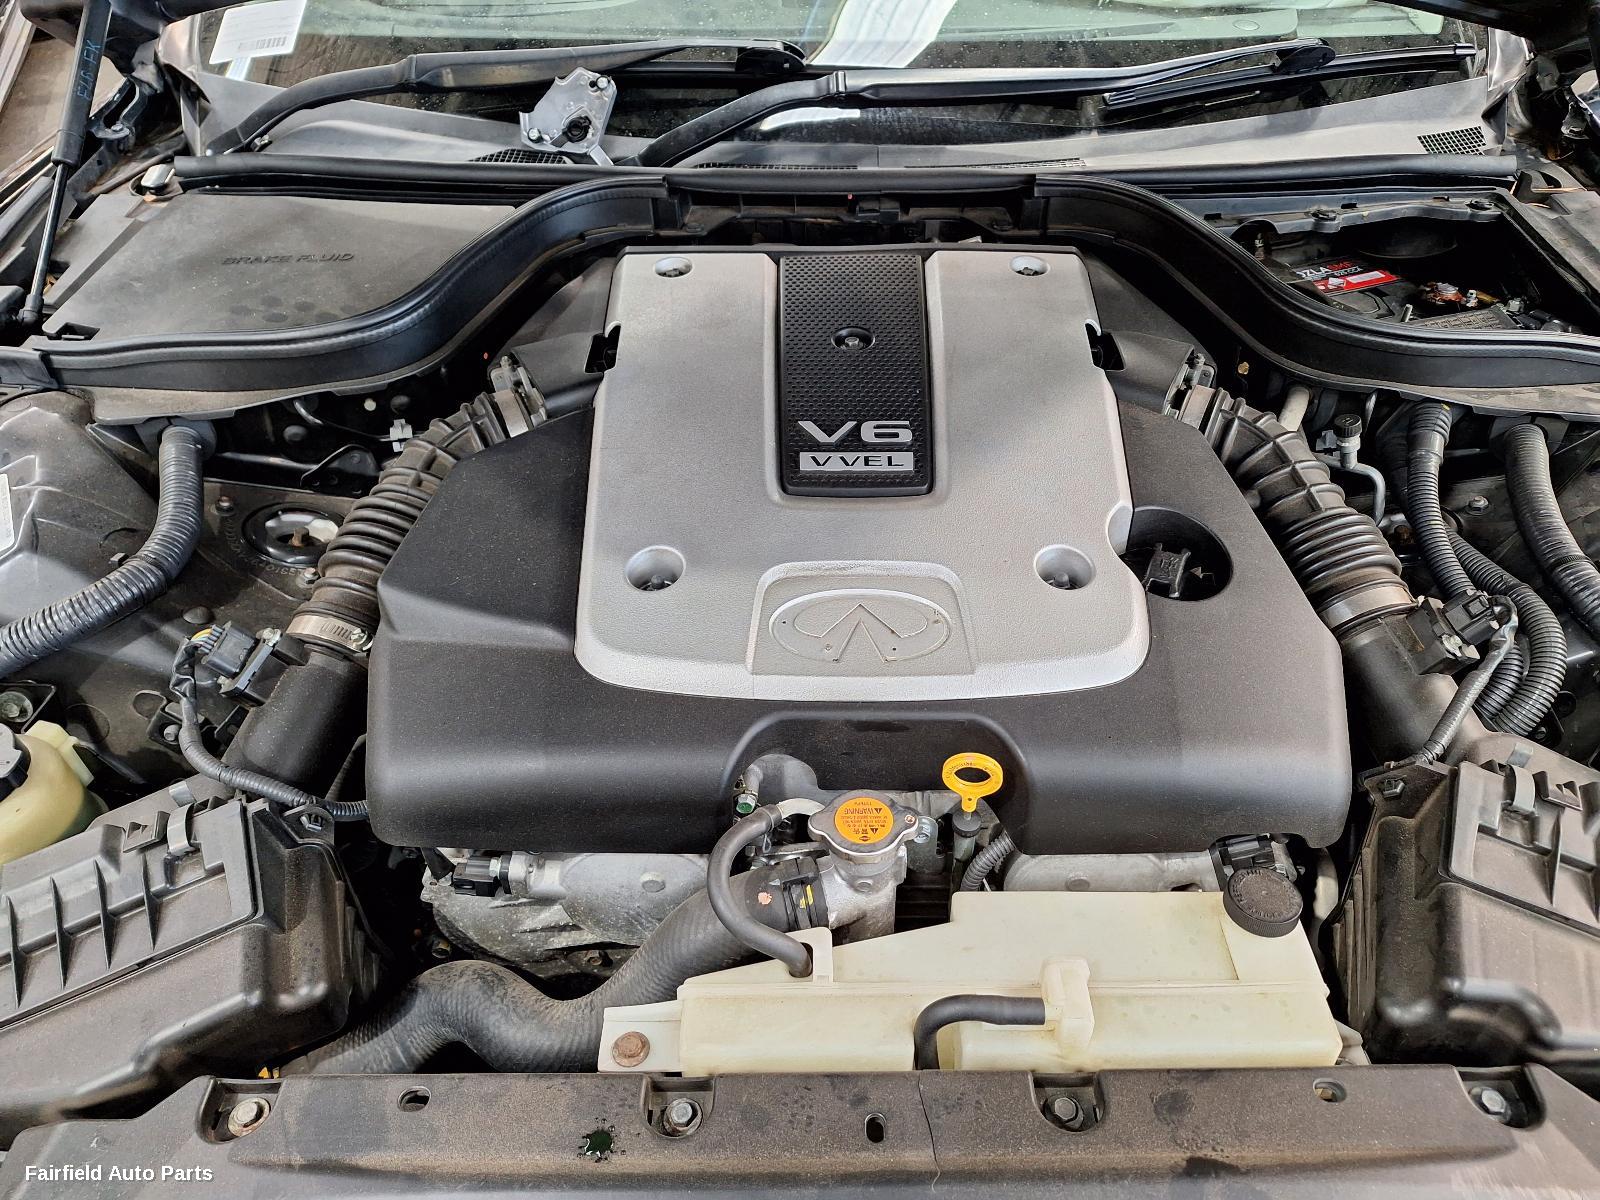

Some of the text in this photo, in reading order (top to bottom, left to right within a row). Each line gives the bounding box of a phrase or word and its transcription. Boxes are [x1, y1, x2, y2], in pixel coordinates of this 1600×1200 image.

[221, 253, 354, 265] BRAKE FLUID
[798, 420, 913, 443] V6
[809, 455, 905, 467] VVEL
